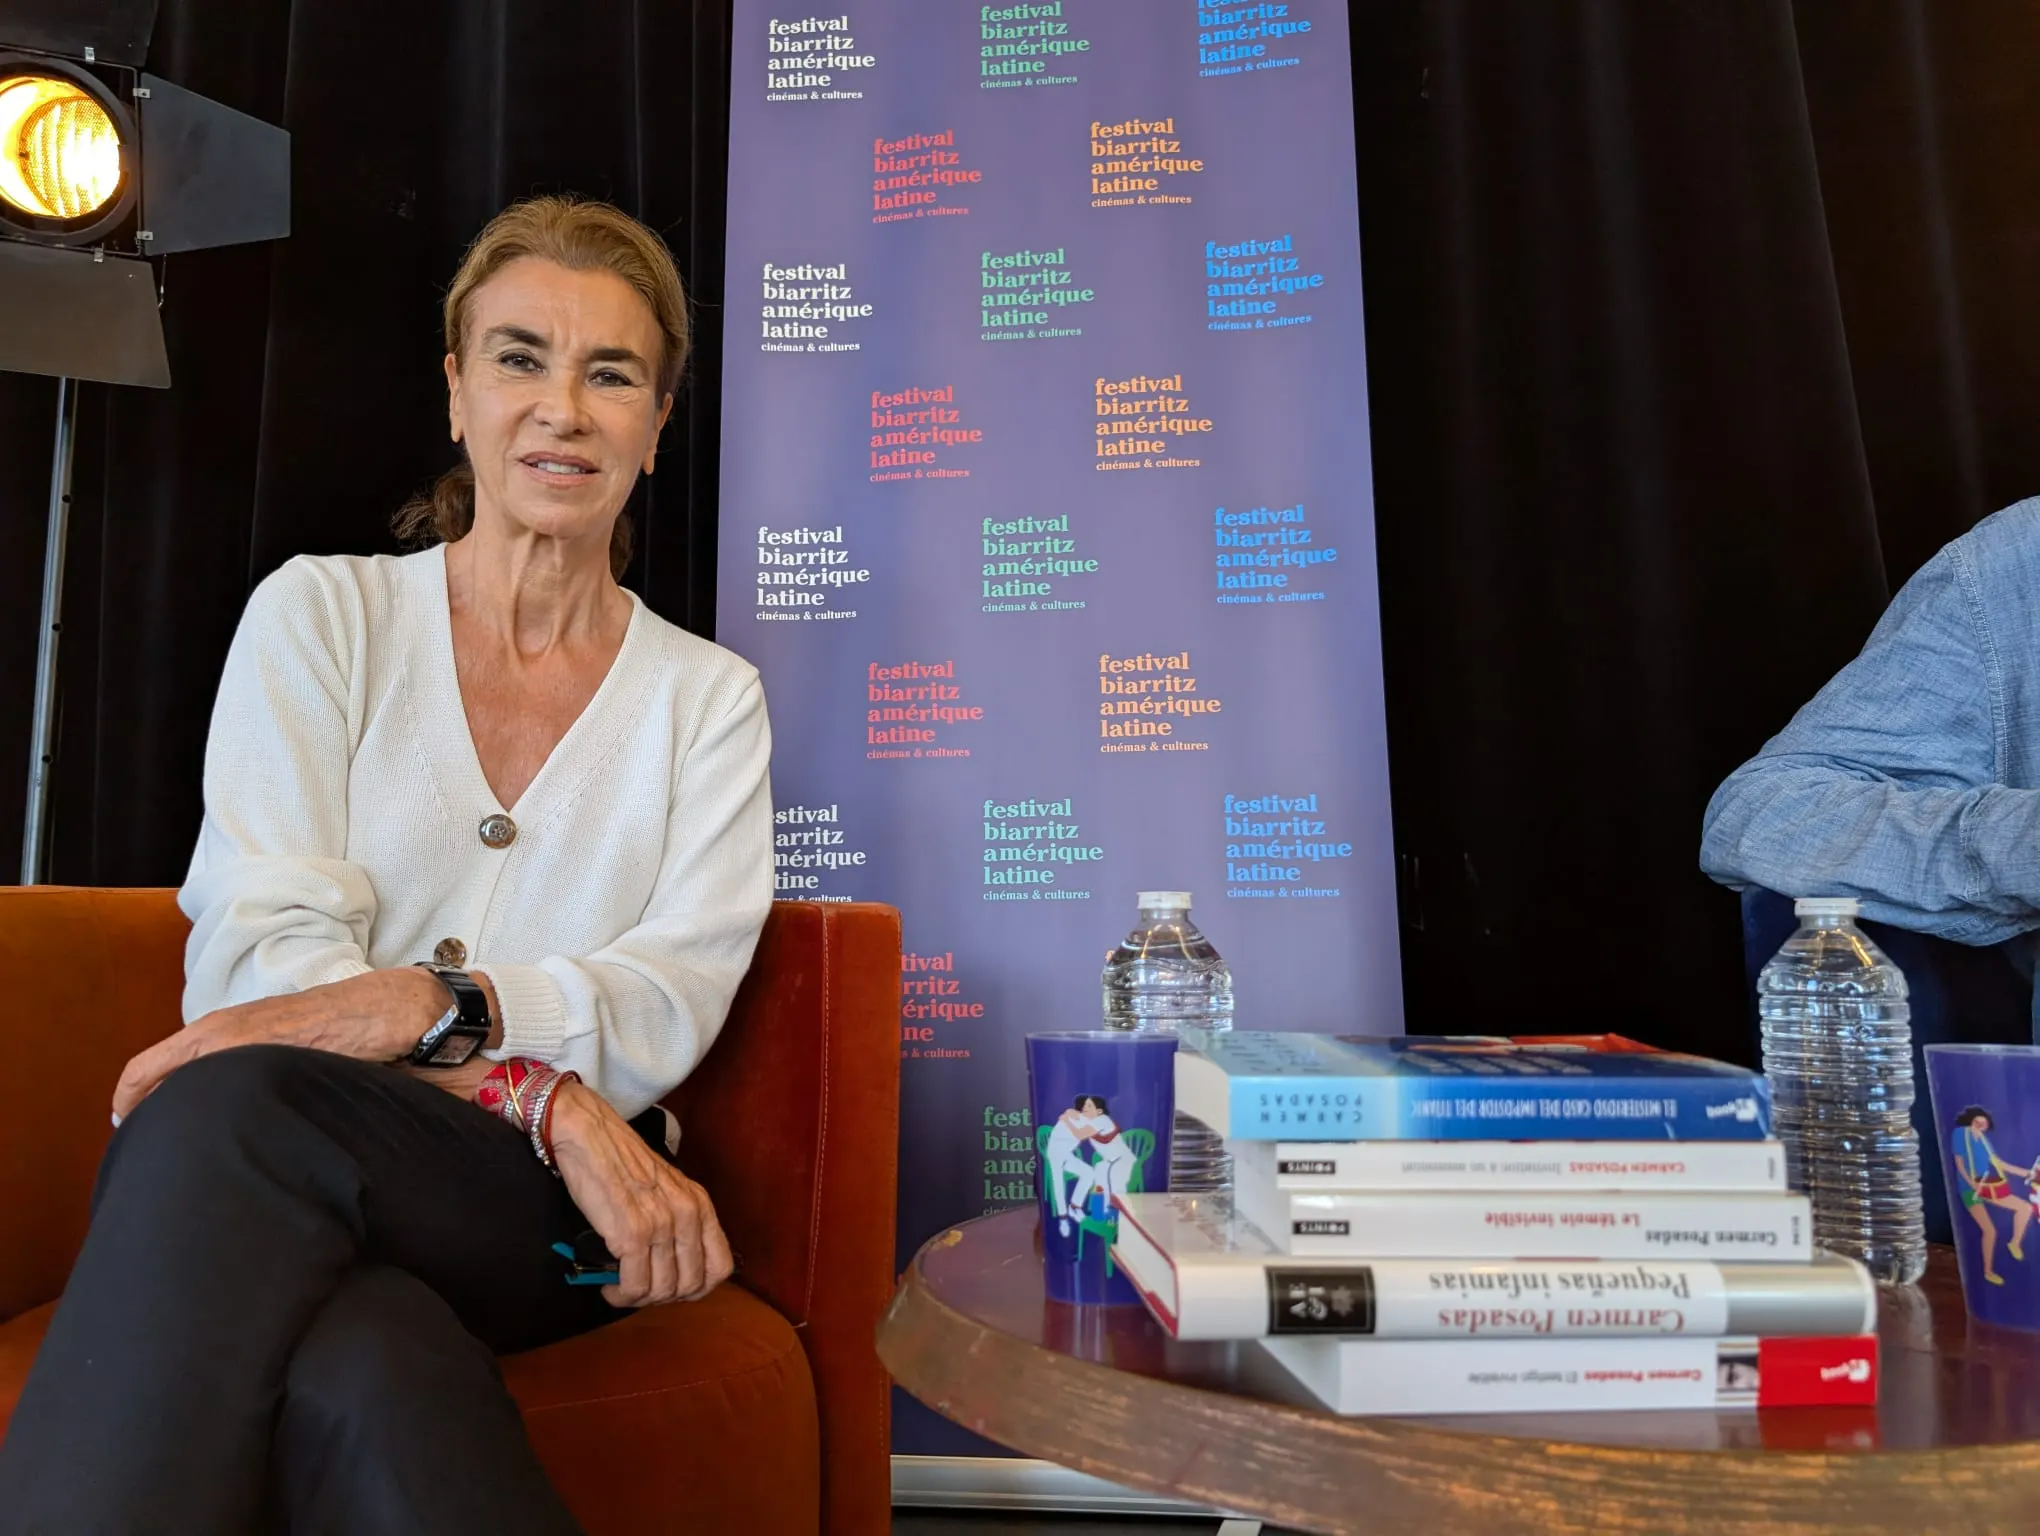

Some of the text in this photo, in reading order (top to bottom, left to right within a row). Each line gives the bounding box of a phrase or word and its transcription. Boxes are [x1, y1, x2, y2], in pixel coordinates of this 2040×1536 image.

[981, 1, 1061, 21] festival
[1199, 3, 1287, 26] biarritz
[769, 16, 848, 35] festival
[981, 20, 1067, 40] biarritz
[1199, 21, 1311, 45] amérique
[769, 35, 853, 52] biarritz
[981, 38, 1089, 57] amérique
[768, 53, 875, 70] amérique
[1200, 44, 1265, 64] latine
[982, 59, 1045, 75] latine
[1200, 58, 1299, 76] cinémas cultures
[768, 72, 831, 88] latine
[980, 76, 1077, 88] cinémas cultures
[767, 91, 862, 101] cinémas & cultures
[1091, 118, 1173, 140] festival
[874, 128, 954, 155] festival
[1091, 137, 1180, 156] biarritz
[874, 149, 960, 173] biarritz
[1091, 156, 1203, 175] amérique
[873, 168, 982, 192] amérique
[1092, 176, 1158, 194] latine
[874, 191, 936, 210] latine
[1092, 195, 1191, 207] cinémas & cultures
[873, 207, 969, 223] cinémas cultures
[1206, 234, 1292, 259] festival
[982, 248, 1064, 269] festival
[1207, 257, 1298, 278] biarritz
[764, 264, 845, 281] festival
[982, 268, 1071, 288] biarritz
[763, 283, 851, 300] biarritz
[1208, 274, 1323, 296] amérique
[982, 288, 1094, 306] amérique
[763, 302, 872, 321] amérique
[1208, 299, 1276, 316] latine
[982, 309, 1048, 326] latine
[1208, 316, 1312, 330] cinémas cultures
[763, 321, 828, 338] latine
[981, 328, 1081, 340] cinémas cultures
[761, 342, 860, 352] cinémas & cultures
[1096, 375, 1182, 395] festival
[872, 385, 953, 408] festival
[1096, 396, 1188, 416] biarritz
[872, 406, 959, 428] biarritz
[1096, 415, 1212, 435] amérique
[871, 426, 982, 448] amérique
[1097, 438, 1165, 456] latine
[872, 448, 935, 468] latine
[1096, 458, 1200, 470] cinémas & cultures
[870, 468, 969, 482] cinémas cultures
[1215, 504, 1304, 526] festival
[983, 515, 1068, 535] festival
[758, 527, 842, 545] festival
[1216, 527, 1311, 547] biarritz
[983, 536, 1074, 556] biarritz
[758, 547, 848, 565] biarritz
[1216, 548, 1336, 568] amérique
[983, 557, 1098, 576] amérique
[757, 568, 869, 587] amérique
[1217, 570, 1287, 588] latine
[757, 588, 824, 606] latine
[983, 579, 1051, 597] latine
[982, 600, 1085, 612] cinémas & cultures
[1216, 592, 1325, 604] cinémas cultures
[756, 610, 856, 620] cinémas & cultures
[868, 661, 953, 680] festival
[1100, 652, 1189, 673] festival
[869, 682, 959, 702] biarritz
[1100, 675, 1196, 694] biarritz
[868, 703, 983, 724] amérique
[1100, 696, 1221, 716] amérique
[868, 726, 935, 744] latine
[1102, 719, 1171, 737] latine
[867, 748, 970, 758] cinémas cultures
[1101, 741, 1208, 752] cinémas & cultures
[984, 799, 1071, 818] festival
[1225, 794, 1317, 814] festival
[773, 805, 838, 824] stival
[984, 821, 1078, 840] biarritz
[1225, 816, 1325, 836] biarritz
[776, 828, 844, 845] arritz
[774, 849, 866, 870] mérique
[984, 843, 1103, 864] amérique
[1226, 839, 1352, 861] amérique
[775, 872, 819, 889] tine
[984, 866, 1054, 885] latine
[1227, 863, 1300, 881] latine
[983, 889, 1090, 901] cinémas & cultures
[1227, 887, 1340, 898] cinémas cultures
[902, 953, 954, 972] tival
[903, 976, 960, 995] rritz
[903, 999, 984, 1021] érique
[924, 1047, 970, 1058] cultures
[1260, 1093, 1364, 1108] POSADAS
[1455, 1098, 1476, 1118] DEL
[1540, 1098, 1561, 1118] DEL
[1562, 1098, 1591, 1118] CASO
[1664, 1098, 1677, 1118] EL
[983, 1106, 1032, 1128] fest
[1260, 1111, 1363, 1123] CARMEN
[1569, 1162, 1628, 1173] POSADAS
[1630, 1162, 1685, 1173] CARMEN
[1484, 1212, 1553, 1227] invisible
[1622, 1212, 1640, 1226] Le
[1645, 1229, 1710, 1246] Posadas
[1715, 1229, 1778, 1245] Carmen
[1429, 1267, 1691, 1299] Pequeñas infamias
[1438, 1308, 1684, 1333] Carmen Posadas
[1584, 1370, 1644, 1382] Posadas
[1648, 1369, 1702, 1382] Carmen
